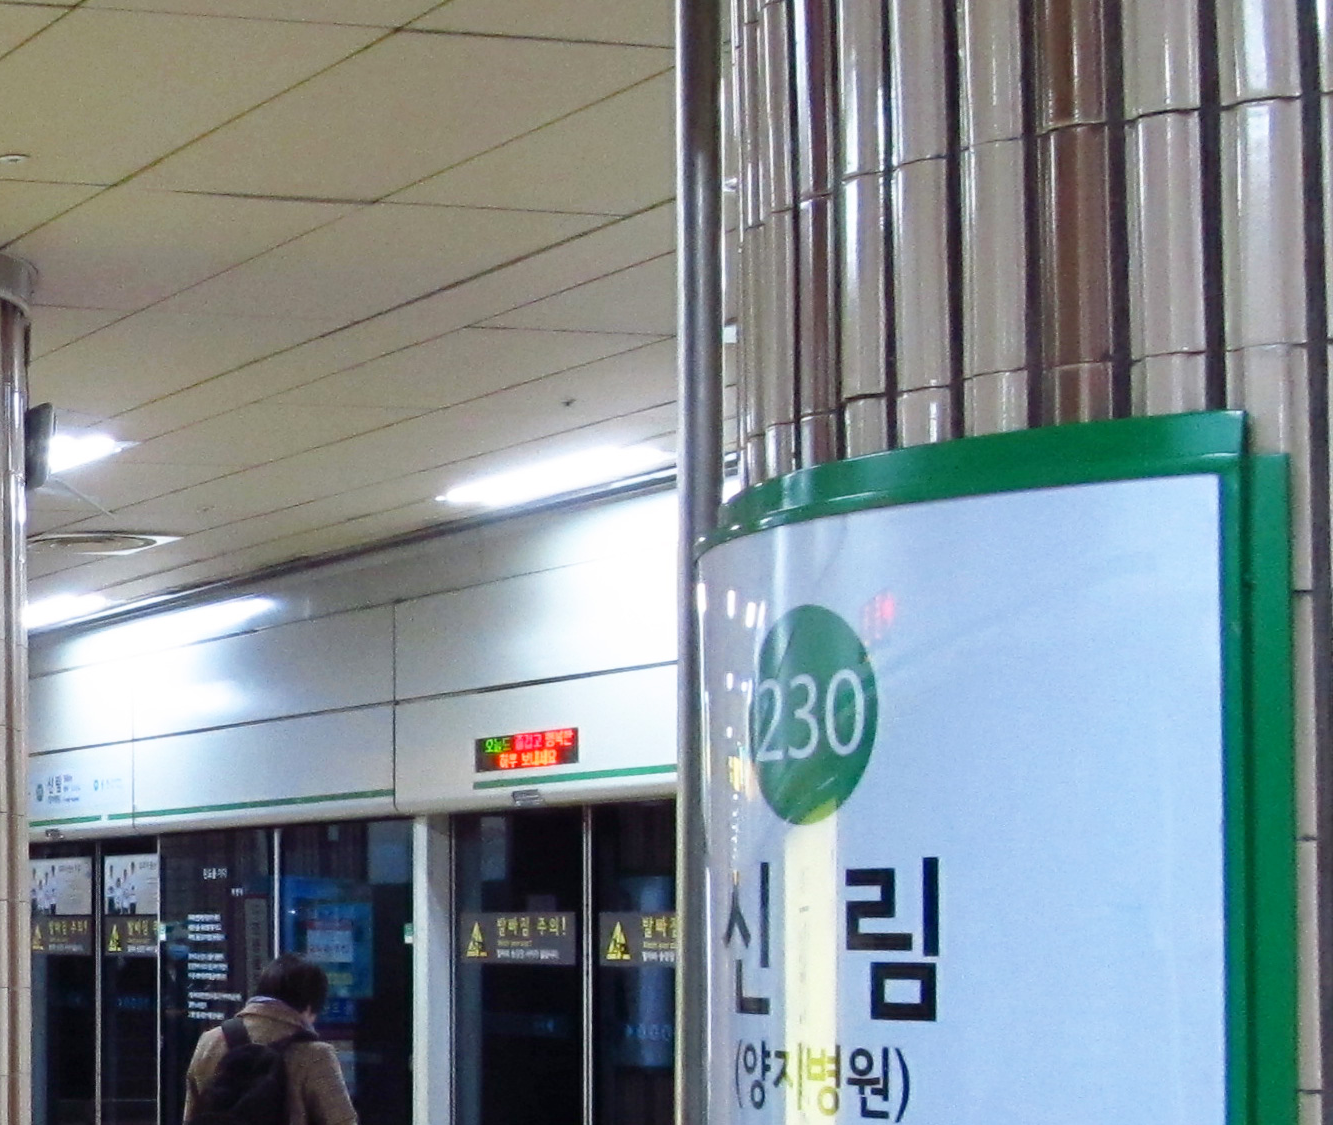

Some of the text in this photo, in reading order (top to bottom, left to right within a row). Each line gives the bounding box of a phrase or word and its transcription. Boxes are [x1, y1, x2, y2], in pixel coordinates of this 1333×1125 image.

[755, 668, 864, 762] 230
[536, 916, 567, 936] 주의!
[736, 1039, 910, 1123] (양지병원)
